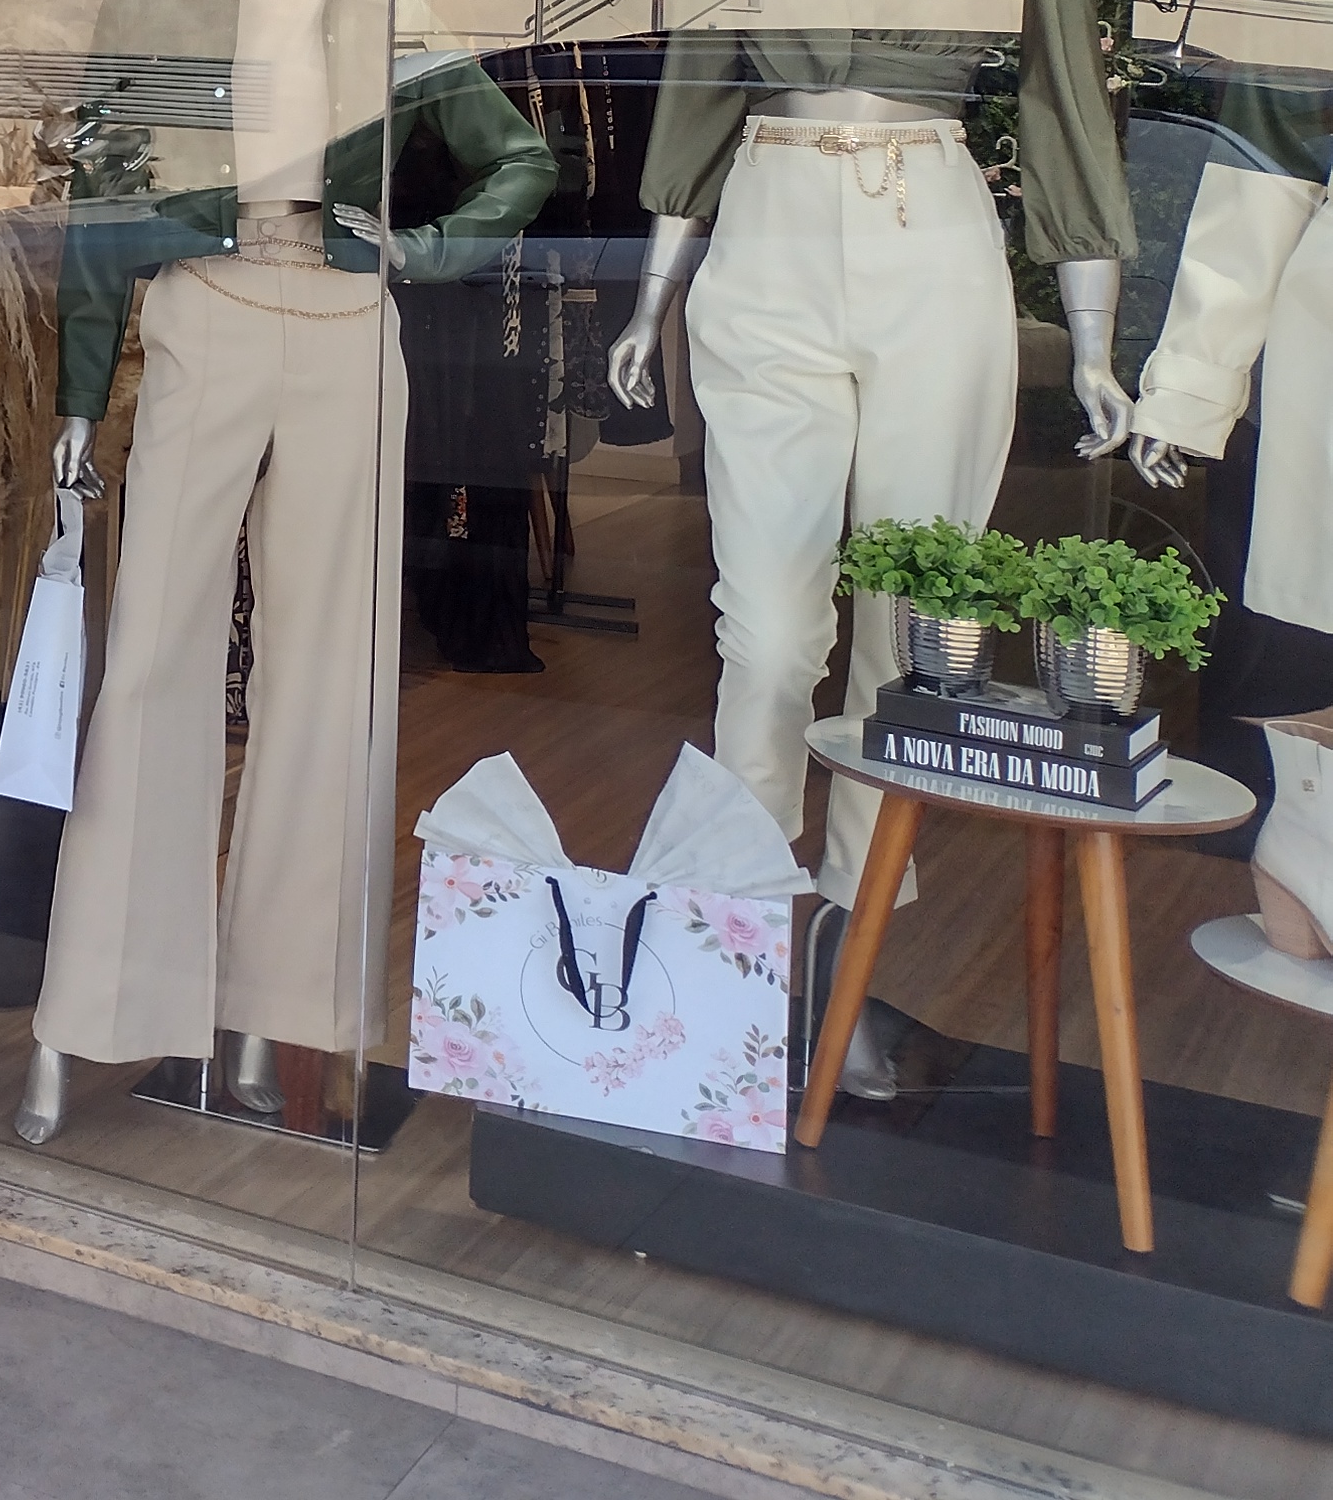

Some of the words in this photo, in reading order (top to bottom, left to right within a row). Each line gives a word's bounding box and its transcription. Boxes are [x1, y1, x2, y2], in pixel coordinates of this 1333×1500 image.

[959, 712, 1019, 743] FASHION
[1022, 723, 1064, 750] MOOD
[883, 733, 898, 761] A
[903, 736, 955, 771] NOVA
[960, 746, 1001, 780] ERA
[1007, 754, 1035, 786] DA
[1041, 761, 1102, 798] MODA
